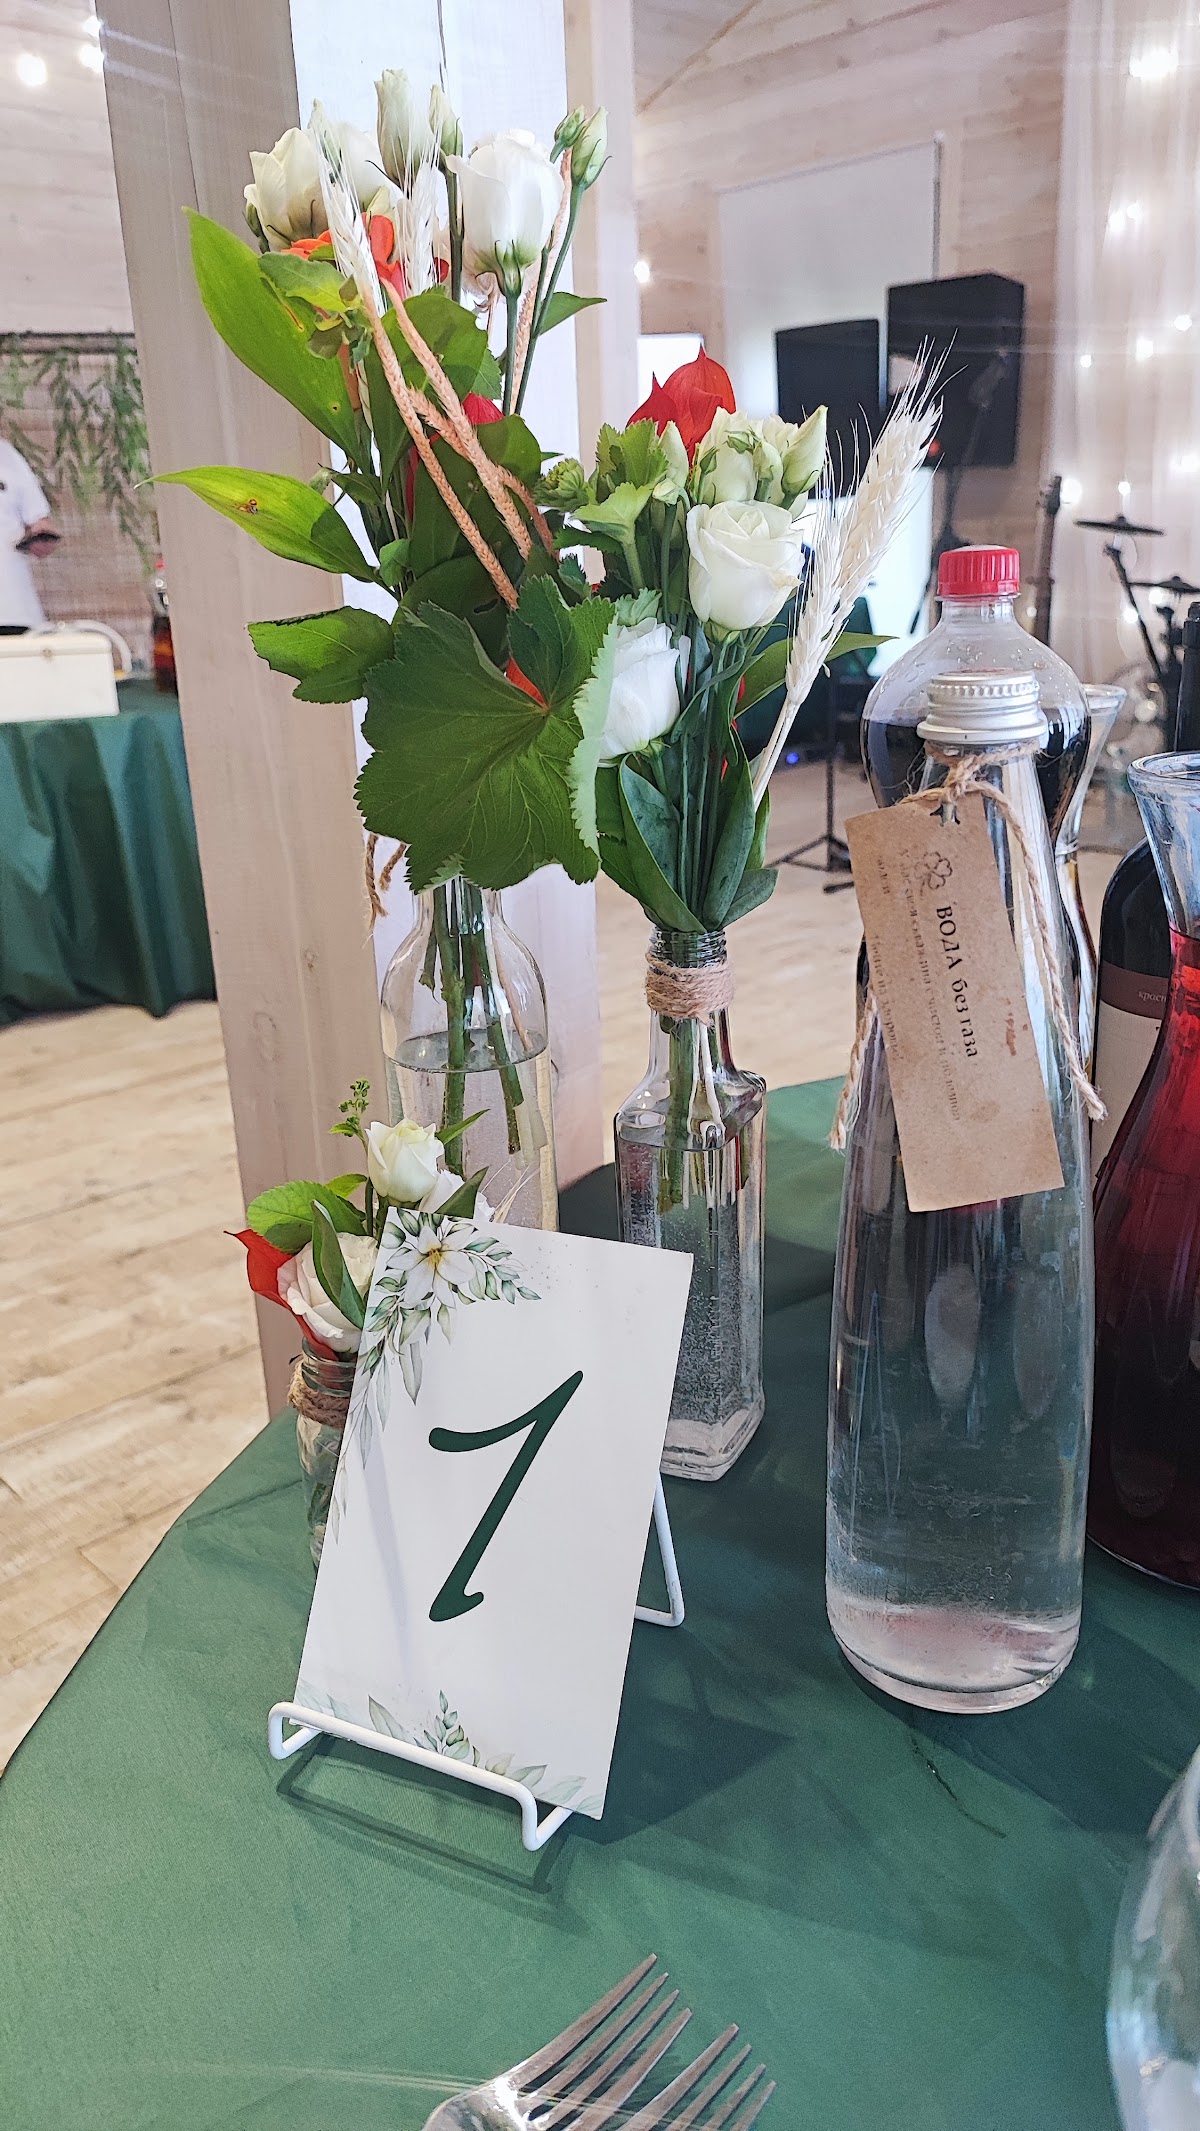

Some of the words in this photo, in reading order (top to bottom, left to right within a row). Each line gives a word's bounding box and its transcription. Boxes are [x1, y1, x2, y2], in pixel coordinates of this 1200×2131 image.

[935, 905, 964, 970] ВОДА
[950, 977, 972, 1014] без
[959, 1017, 978, 1058] газа
[429, 1371, 584, 1622] 1
